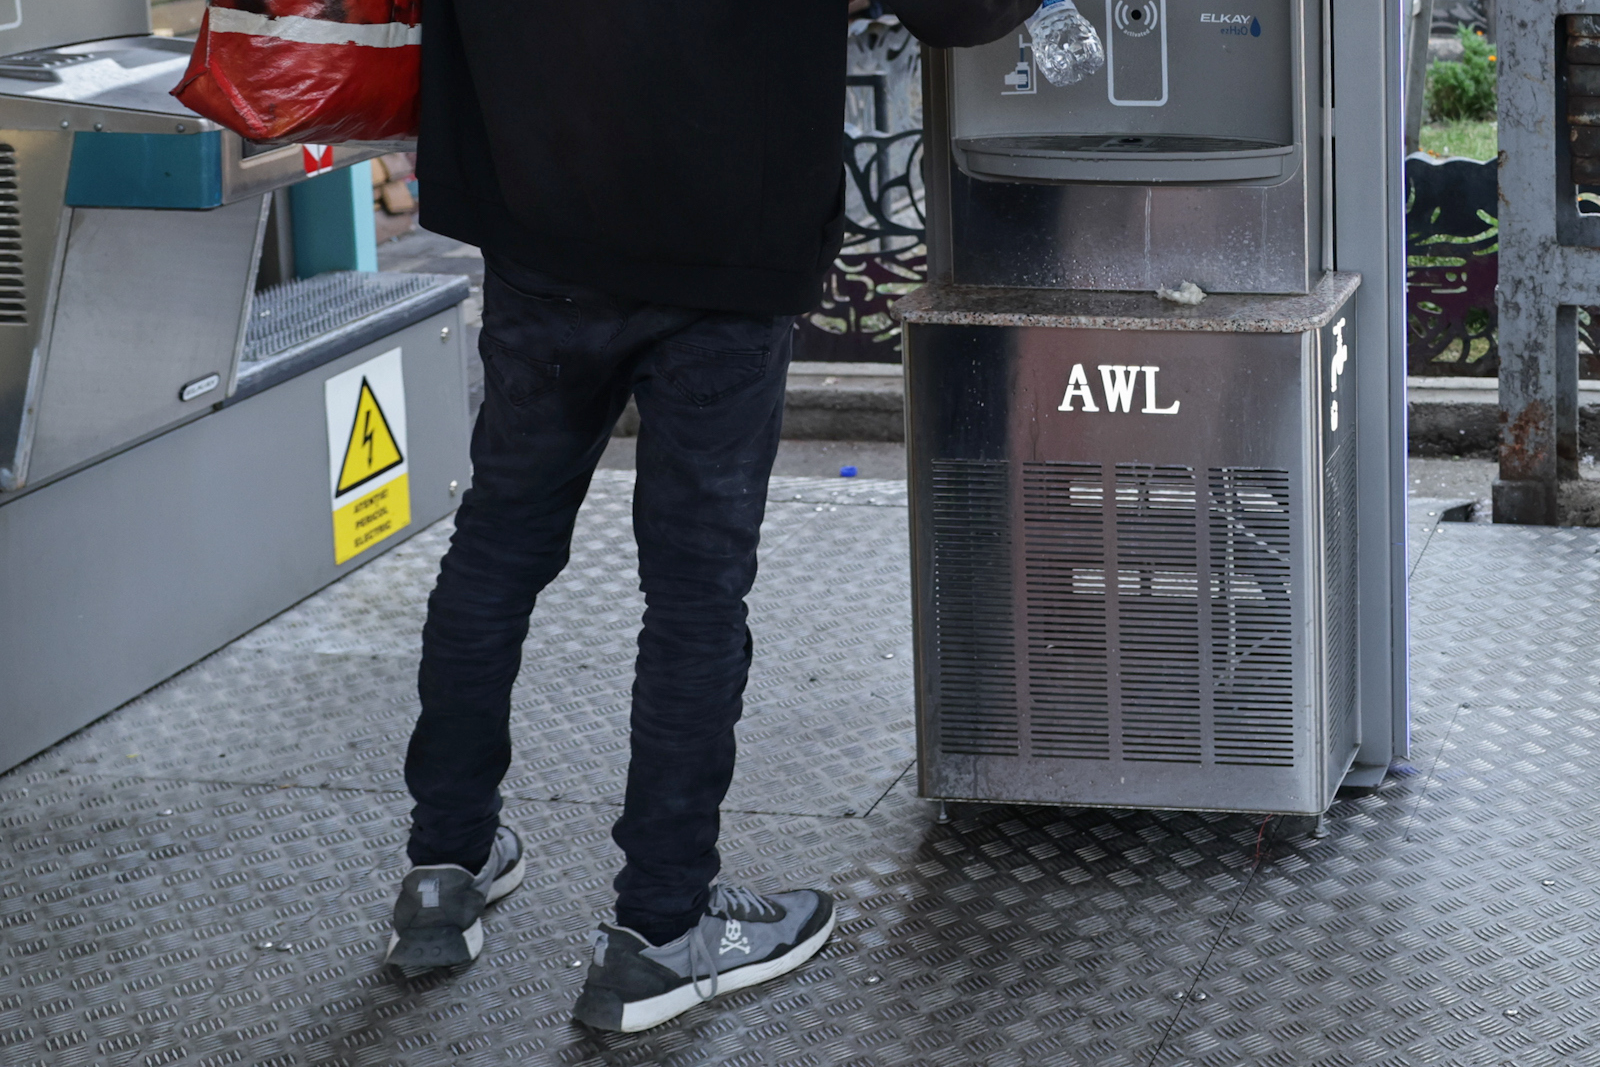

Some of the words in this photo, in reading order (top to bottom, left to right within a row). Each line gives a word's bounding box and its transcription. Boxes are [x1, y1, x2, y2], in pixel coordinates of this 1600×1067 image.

[1200, 13, 1250, 24] ELKAY
[1123, 28, 1150, 38] activated
[1057, 363, 1181, 415] AWL
